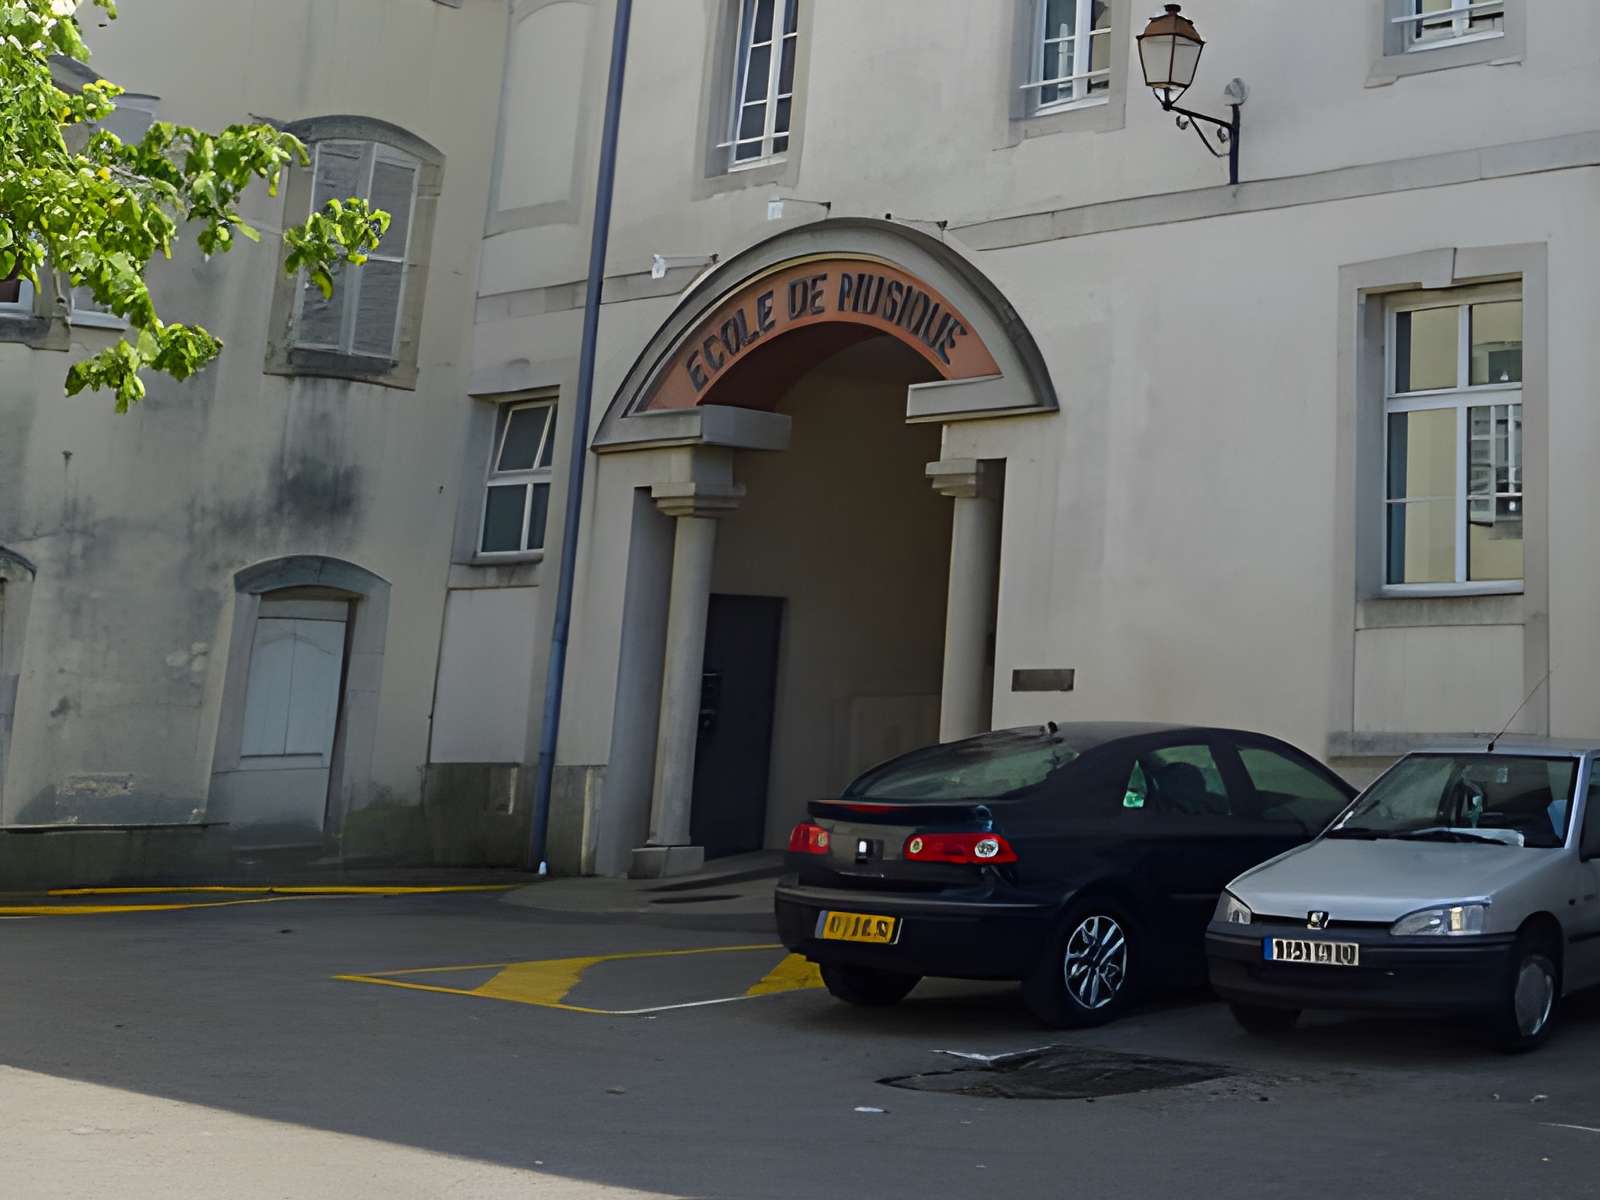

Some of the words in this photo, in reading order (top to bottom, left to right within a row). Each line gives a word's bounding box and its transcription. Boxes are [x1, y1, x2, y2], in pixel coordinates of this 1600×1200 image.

[686, 290, 775, 392] ECOLE
[788, 273, 827, 320] DE
[838, 273, 967, 365] MUSIQUE
